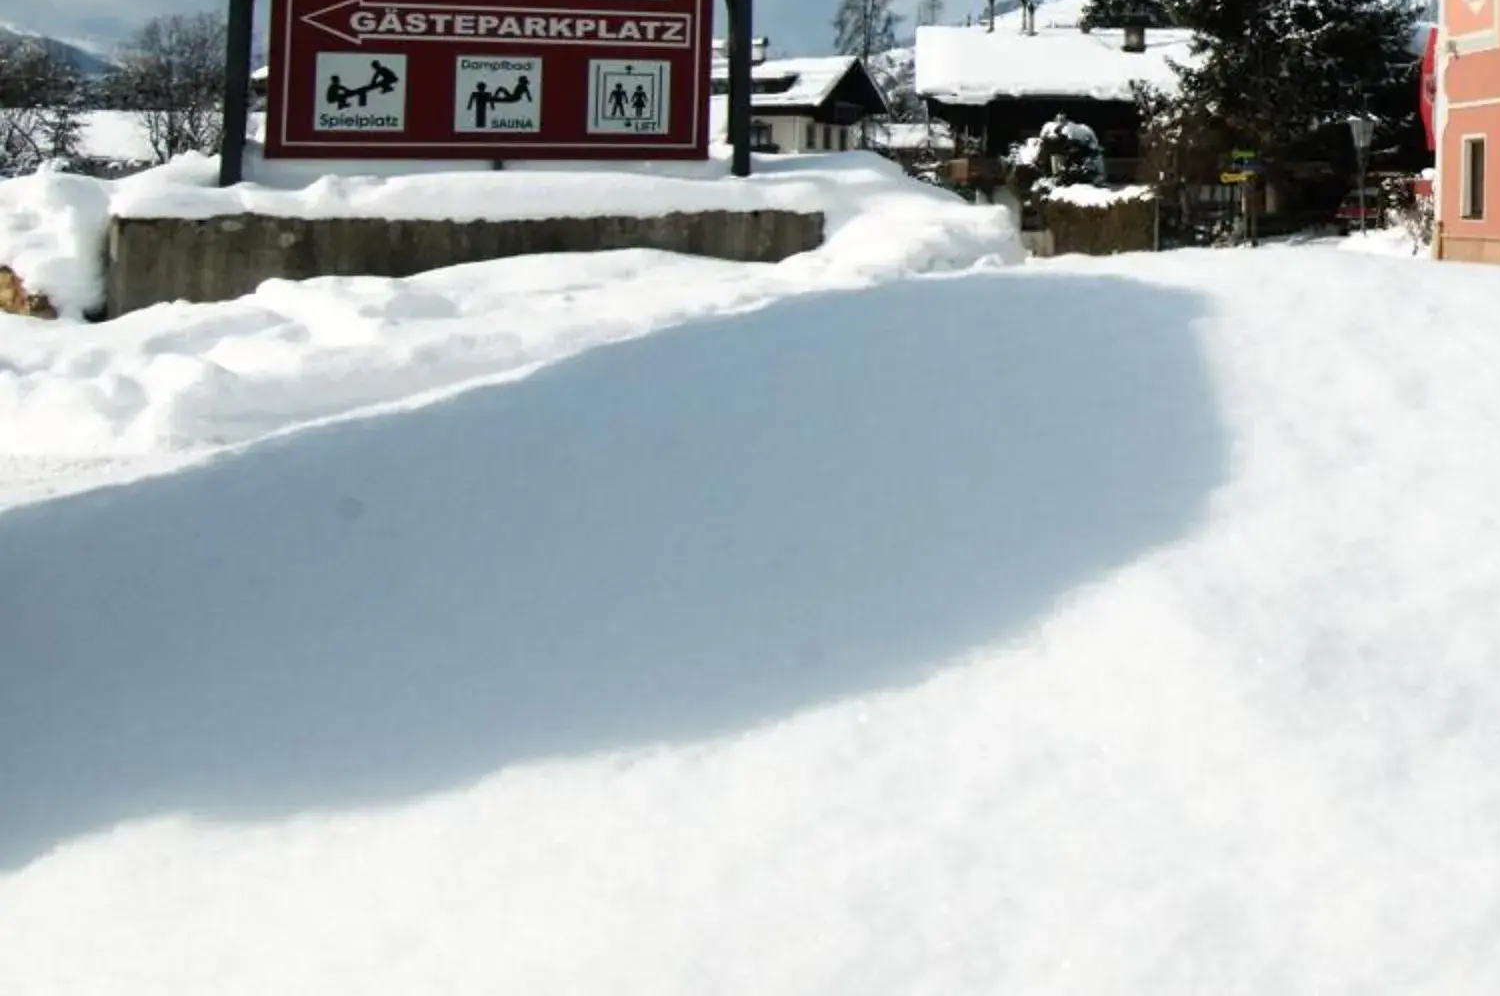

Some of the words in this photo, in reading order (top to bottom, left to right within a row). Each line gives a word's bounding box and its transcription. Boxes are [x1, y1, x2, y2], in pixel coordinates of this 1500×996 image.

[350, 7, 685, 42] GÄSTEPARKPLATZ
[461, 59, 533, 72] Dampfbad
[319, 113, 399, 129] Spielplatz
[491, 117, 533, 129] SAUNA
